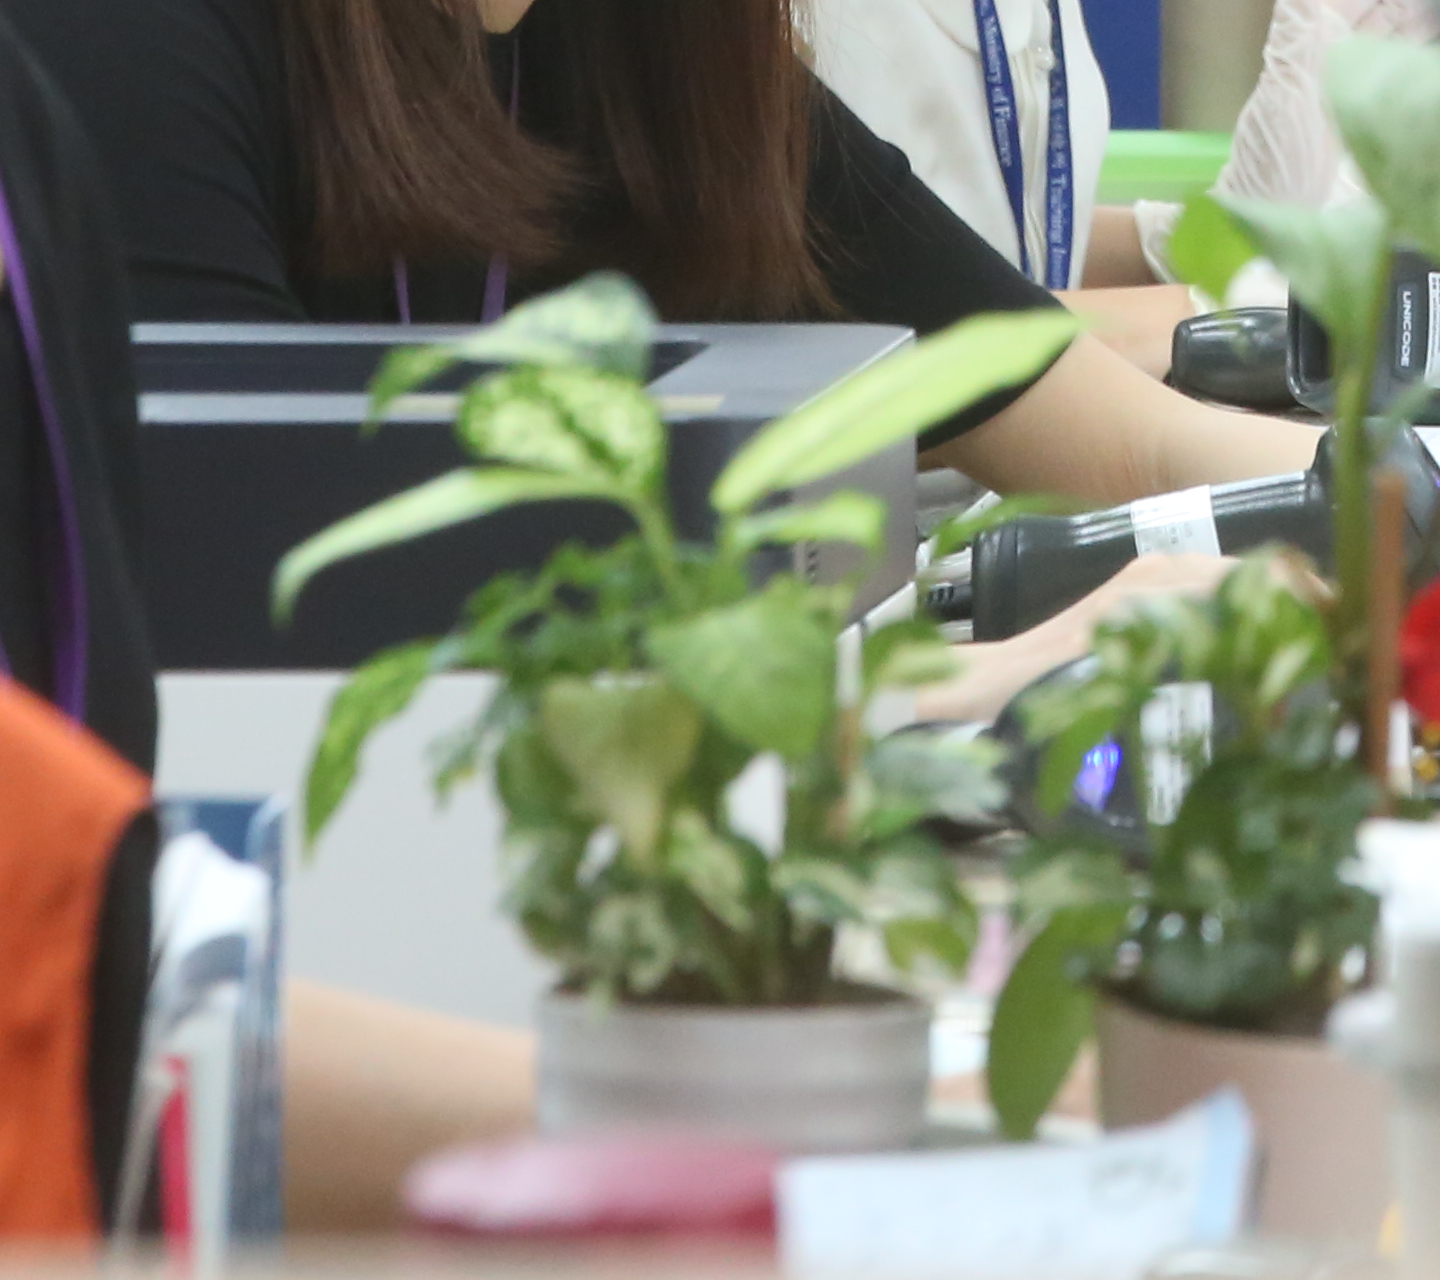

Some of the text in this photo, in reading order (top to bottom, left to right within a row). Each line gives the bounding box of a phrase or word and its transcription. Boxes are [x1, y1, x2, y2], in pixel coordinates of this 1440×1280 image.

[983, 14, 1003, 83] Ministry
[992, 89, 1010, 106] of
[993, 106, 1014, 168] Finance
[1401, 290, 1412, 368] UNICODE
